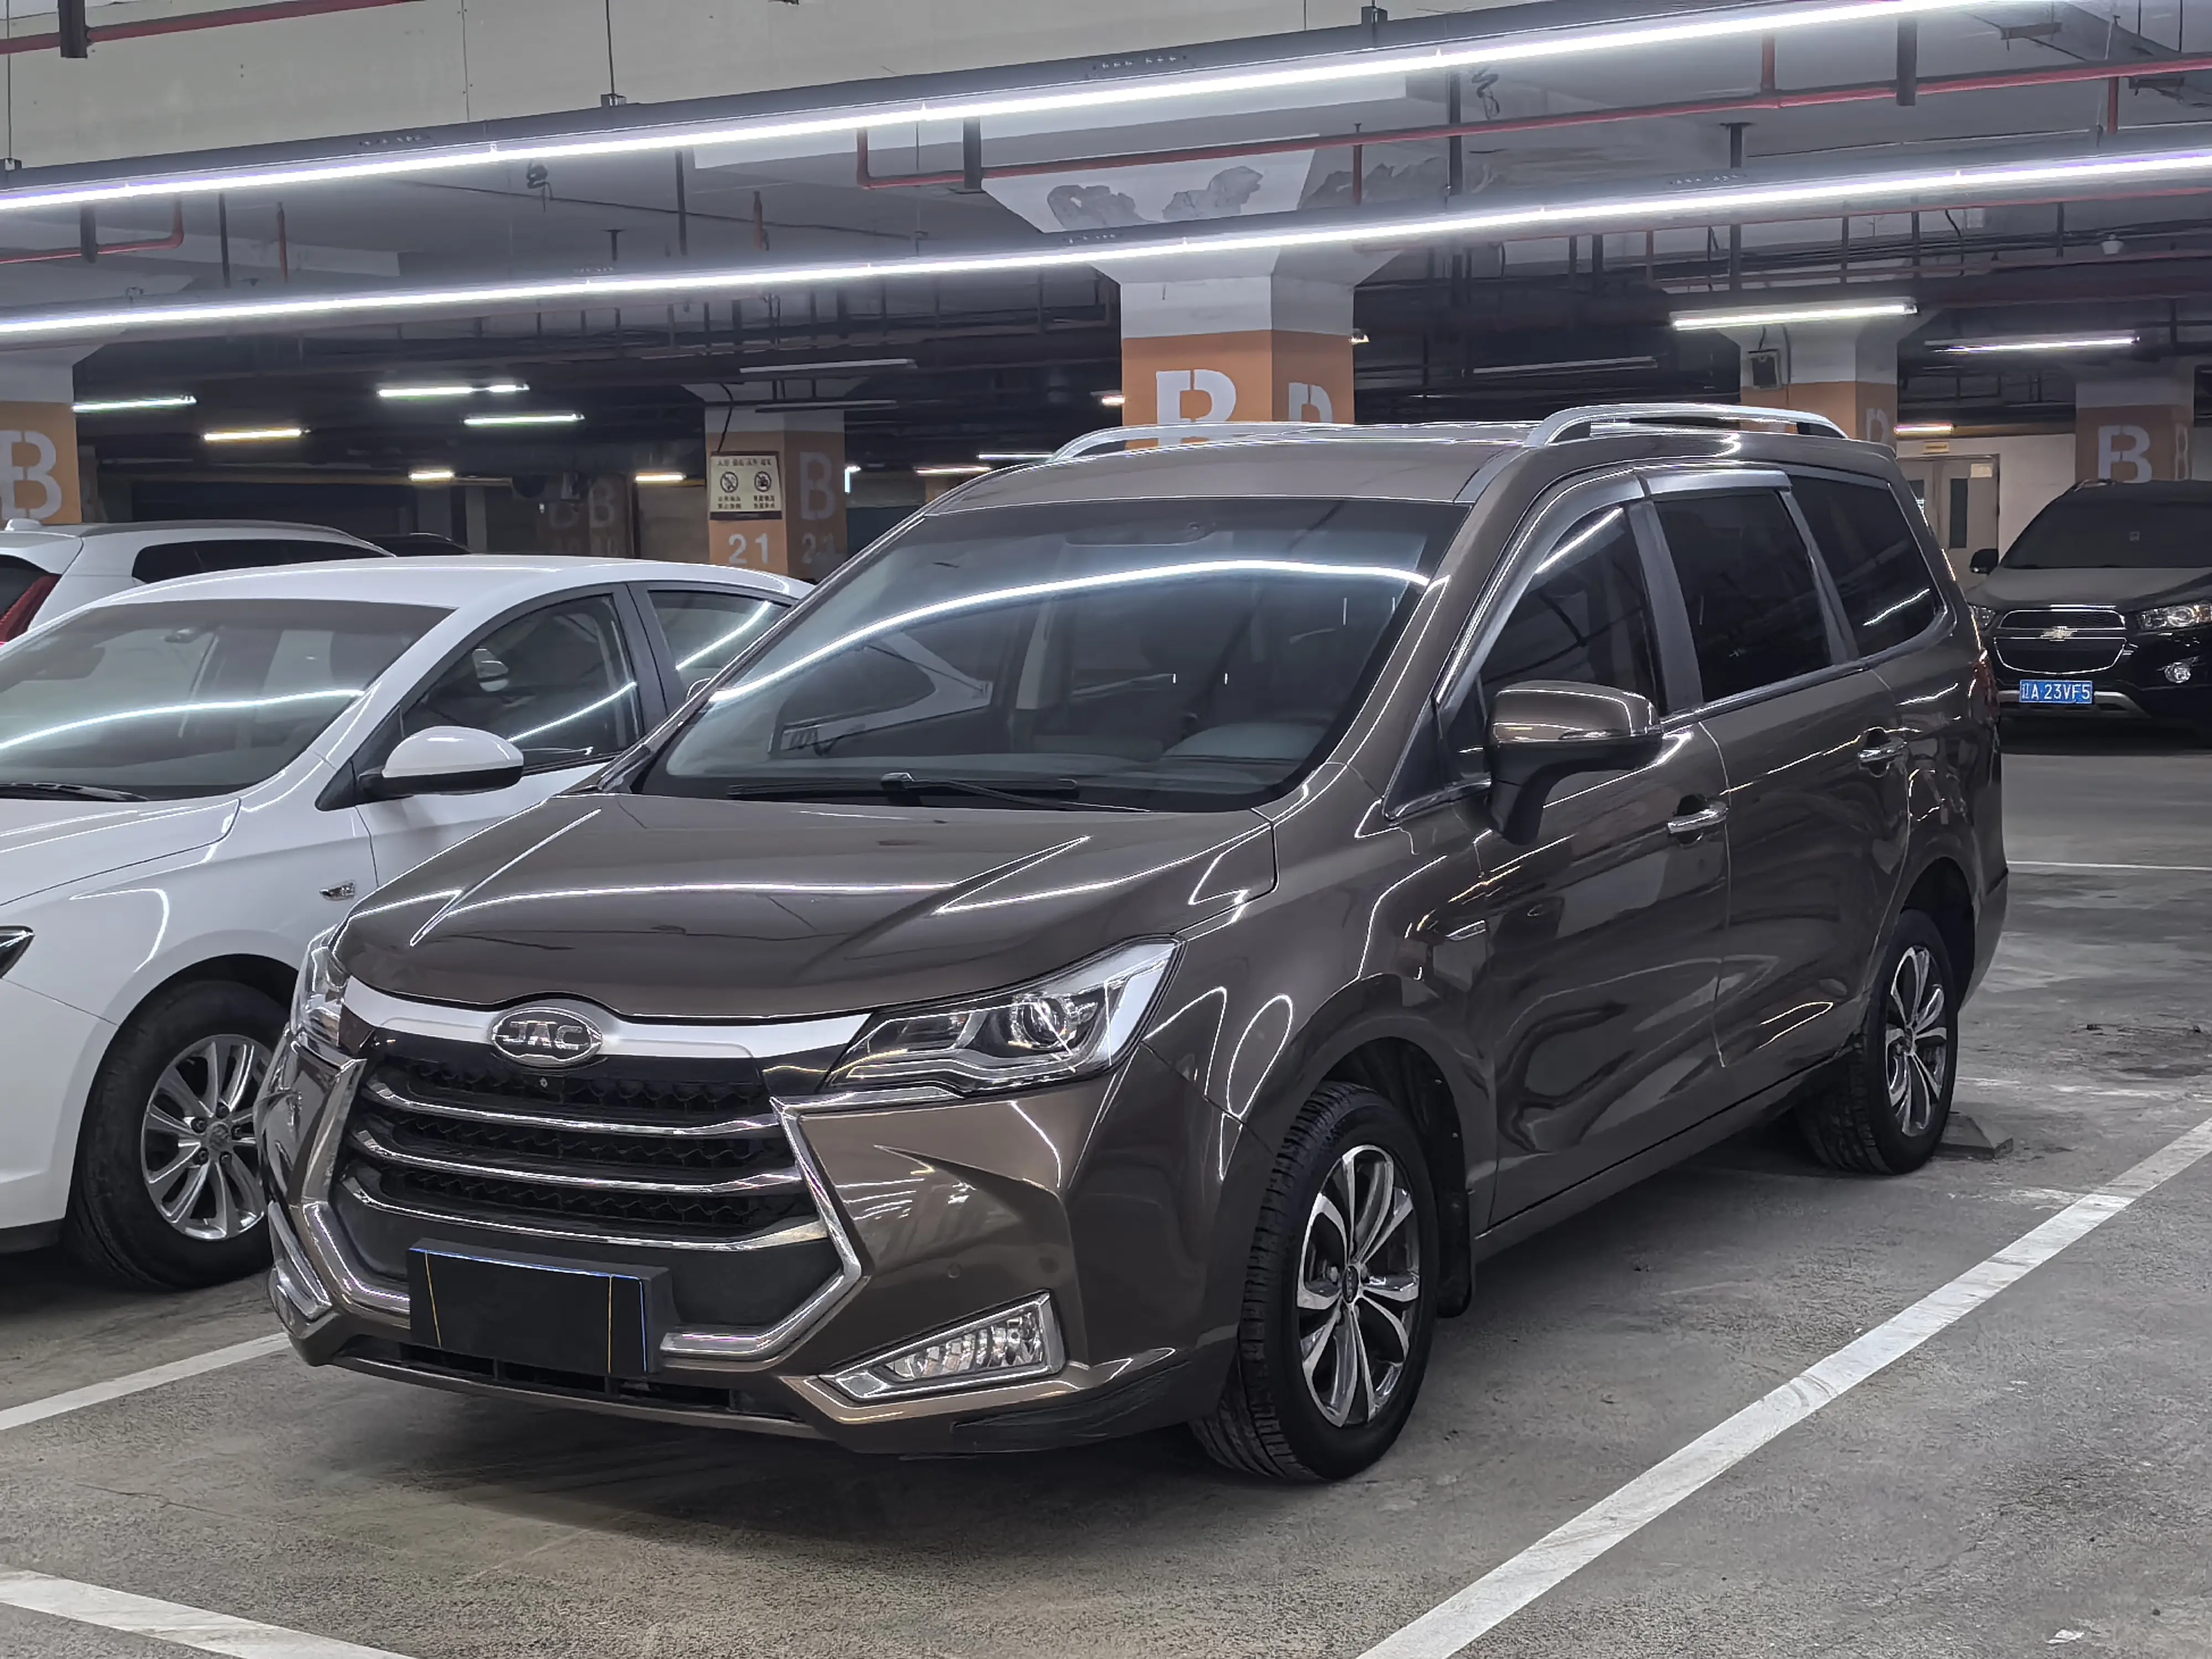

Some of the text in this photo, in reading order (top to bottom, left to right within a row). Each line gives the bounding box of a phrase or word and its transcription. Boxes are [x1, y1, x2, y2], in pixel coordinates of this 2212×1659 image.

[0, 430, 62, 520] B
[2098, 424, 2152, 483] B
[800, 451, 836, 520] B
[728, 533, 769, 565] 21
[496, 1020, 583, 1051] JAC
